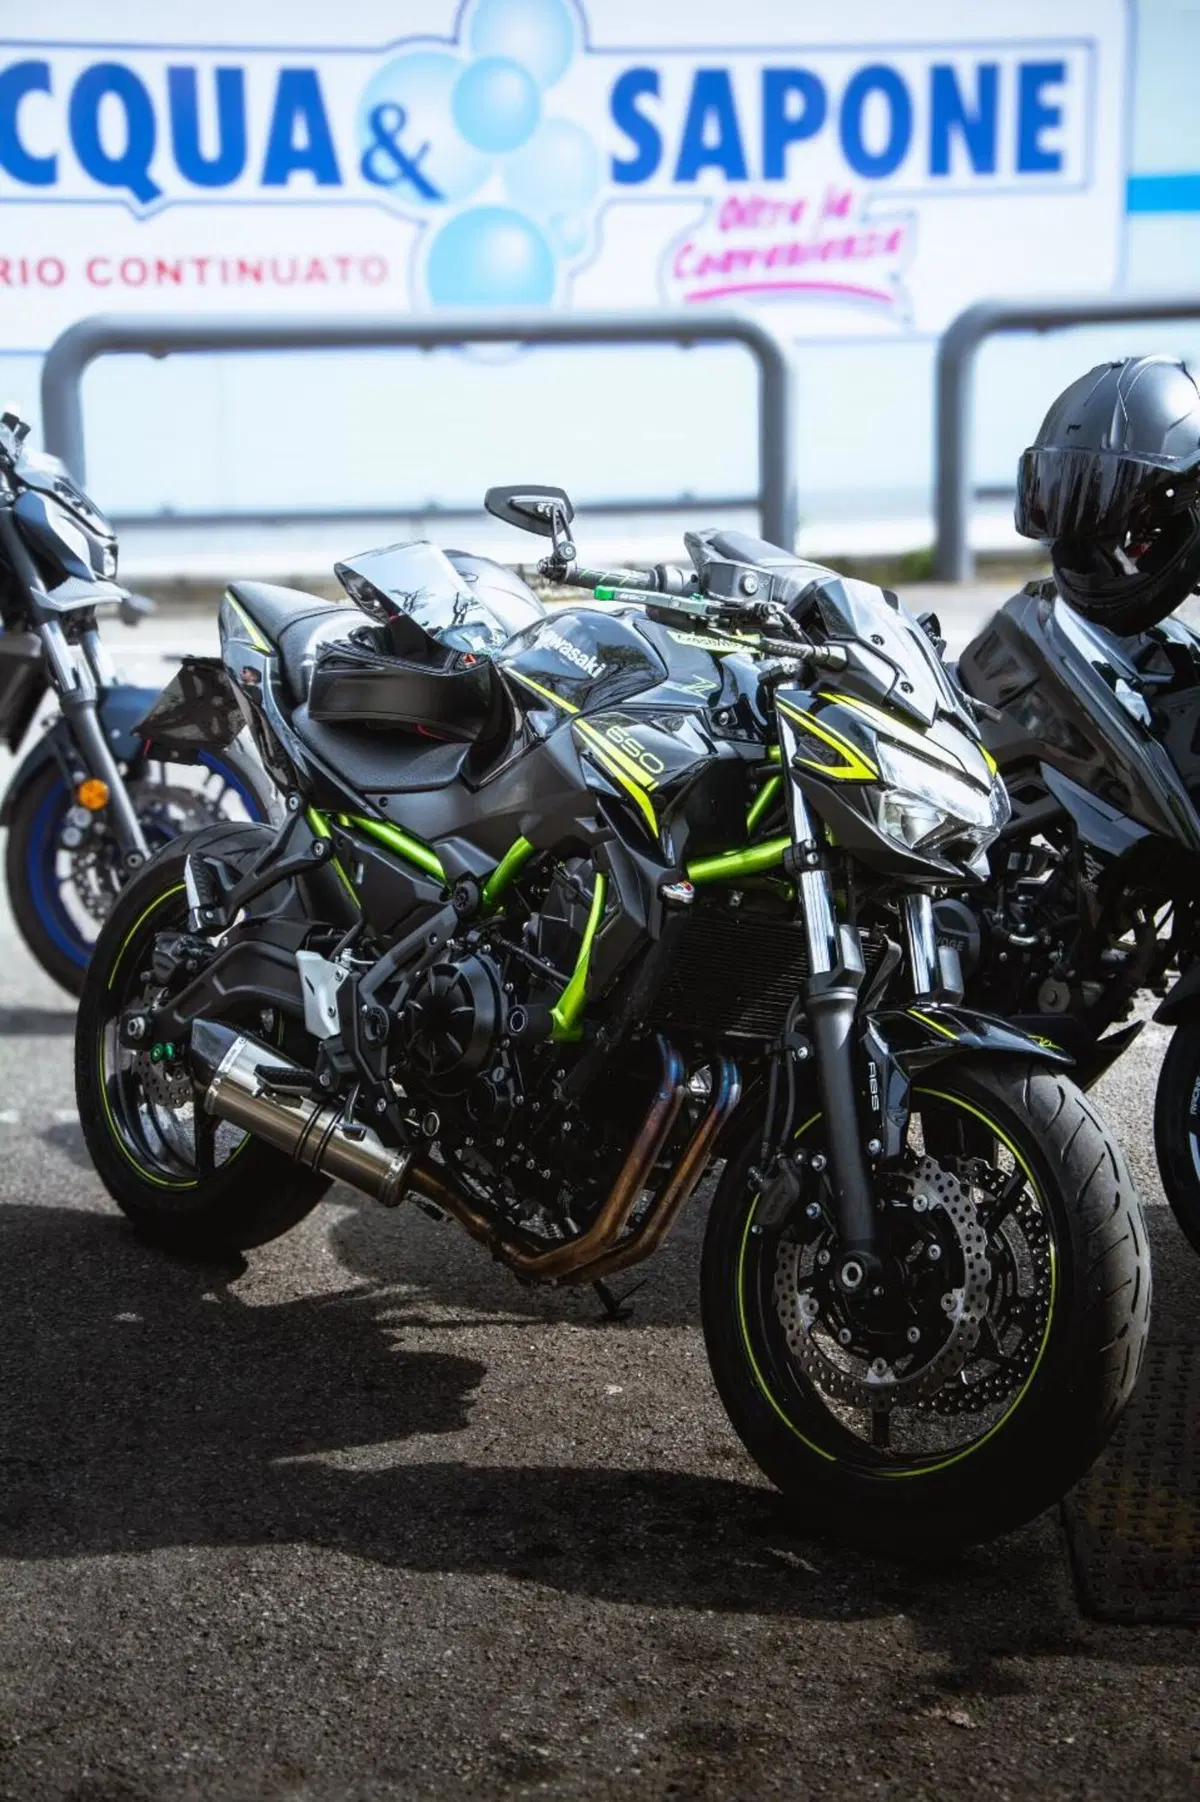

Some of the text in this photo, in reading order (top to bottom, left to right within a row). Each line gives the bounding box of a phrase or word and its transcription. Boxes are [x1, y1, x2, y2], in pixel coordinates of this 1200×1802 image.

[360, 101, 447, 203] &
[609, 61, 1067, 184] SAPONE
[86, 257, 389, 286] CONTINUATO
[606, 725, 665, 774] 650
[868, 1061, 880, 1111] ABS
